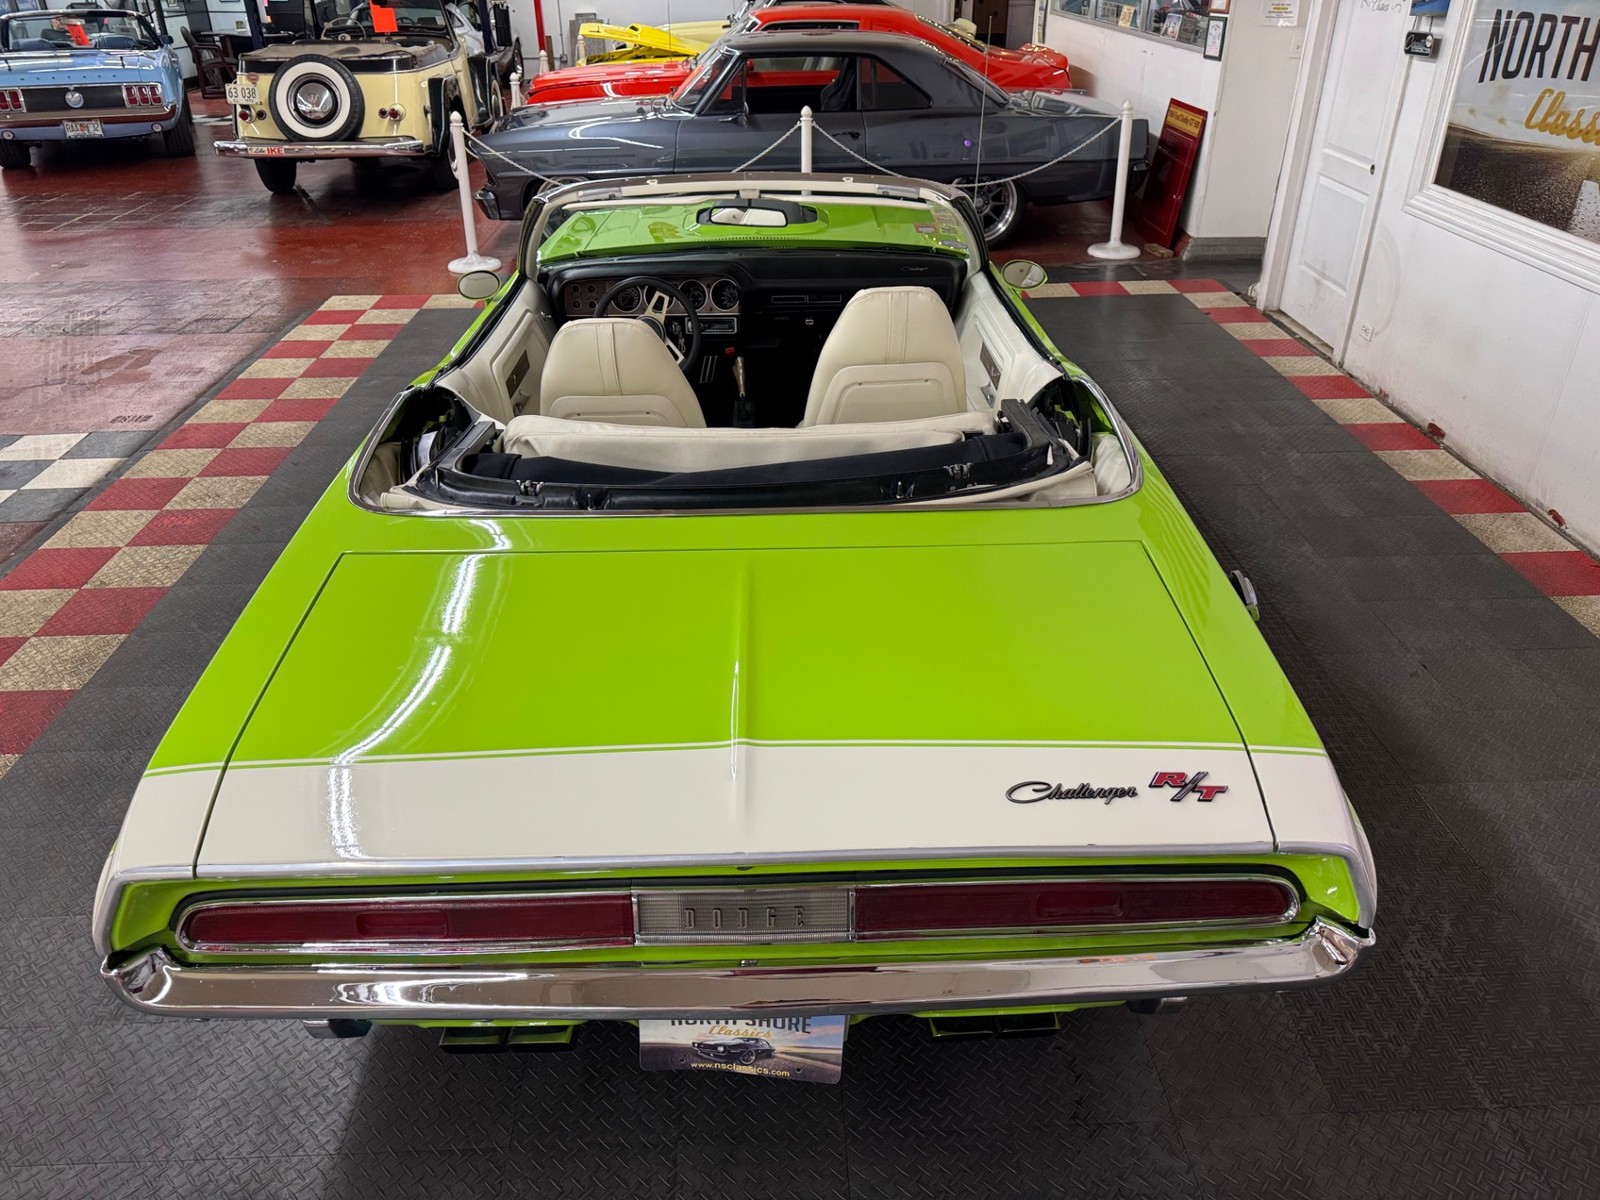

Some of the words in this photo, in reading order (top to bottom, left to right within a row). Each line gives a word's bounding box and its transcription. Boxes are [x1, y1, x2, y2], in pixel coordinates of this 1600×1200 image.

[1478, 9, 1600, 83] NORTH
[228, 87, 238, 98] 63
[1524, 88, 1600, 146] Class
[1005, 780, 1138, 805] Challenger
[1148, 771, 1229, 802] R/T
[684, 906, 804, 929] DODGE
[708, 1025, 772, 1039] Classics
[691, 1061, 790, 1077] www.nsclassics.com
